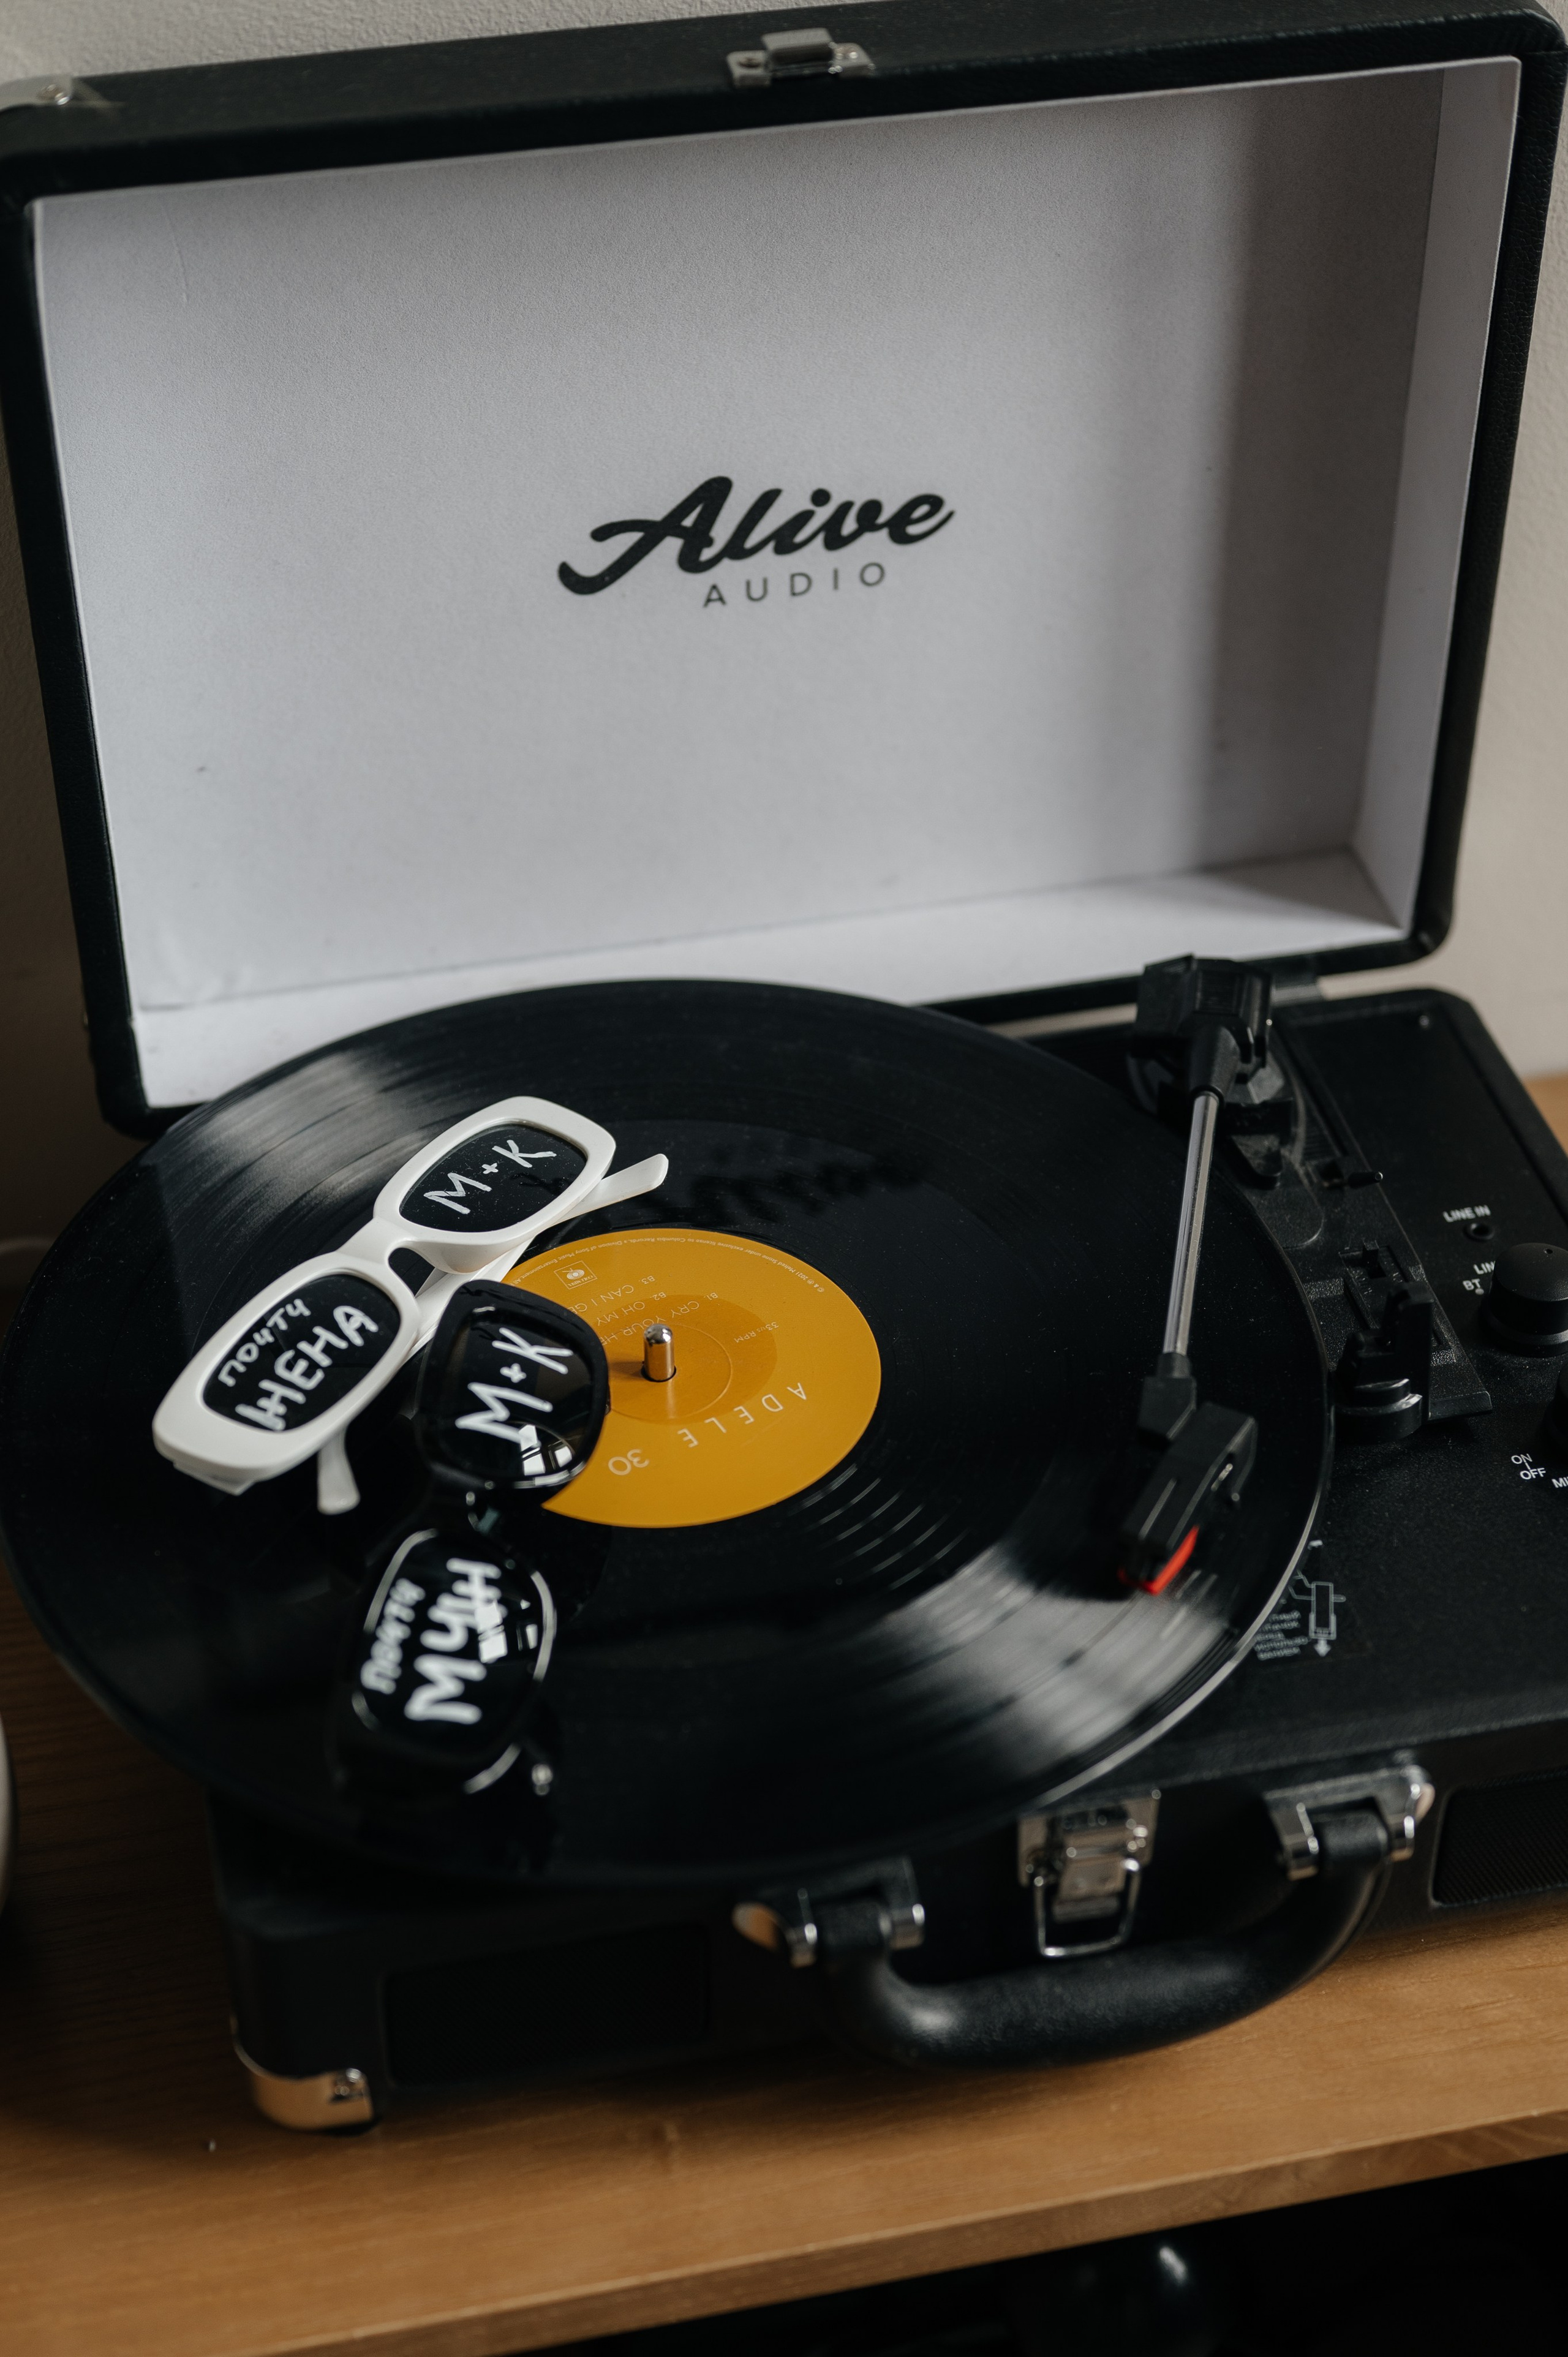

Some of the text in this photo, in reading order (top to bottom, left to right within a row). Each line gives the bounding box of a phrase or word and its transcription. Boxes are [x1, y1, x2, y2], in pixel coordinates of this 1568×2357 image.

[557, 475, 955, 595] Alive
[703, 562, 886, 608] AUDIO
[1442, 1204, 1491, 1223] LINE IN
[598, 1240, 622, 1249] Division
[717, 1242, 744, 1251] exclusive
[558, 1252, 575, 1261] Music
[745, 1248, 761, 1258] under
[762, 1254, 778, 1264] Stone
[777, 1261, 796, 1273] Melted
[1473, 1260, 1496, 1275] LIN
[639, 1275, 655, 1284] B3.
[796, 1271, 809, 1281] 2021
[1462, 1278, 1481, 1291] BT
[599, 1284, 635, 1302] CAN
[567, 1302, 588, 1314] GE
[595, 1291, 667, 1327] B2. OH MY
[669, 1300, 700, 1318] CRY
[620, 1314, 666, 1337] YOUR
[598, 1332, 618, 1346] HE
[733, 1330, 757, 1343] RPM
[677, 1382, 809, 1449] ADELE
[608, 1449, 650, 1476] 30
[1511, 1453, 1533, 1465] ON
[1520, 1467, 1547, 1480] OFF
[1551, 1476, 1568, 1488] MI
